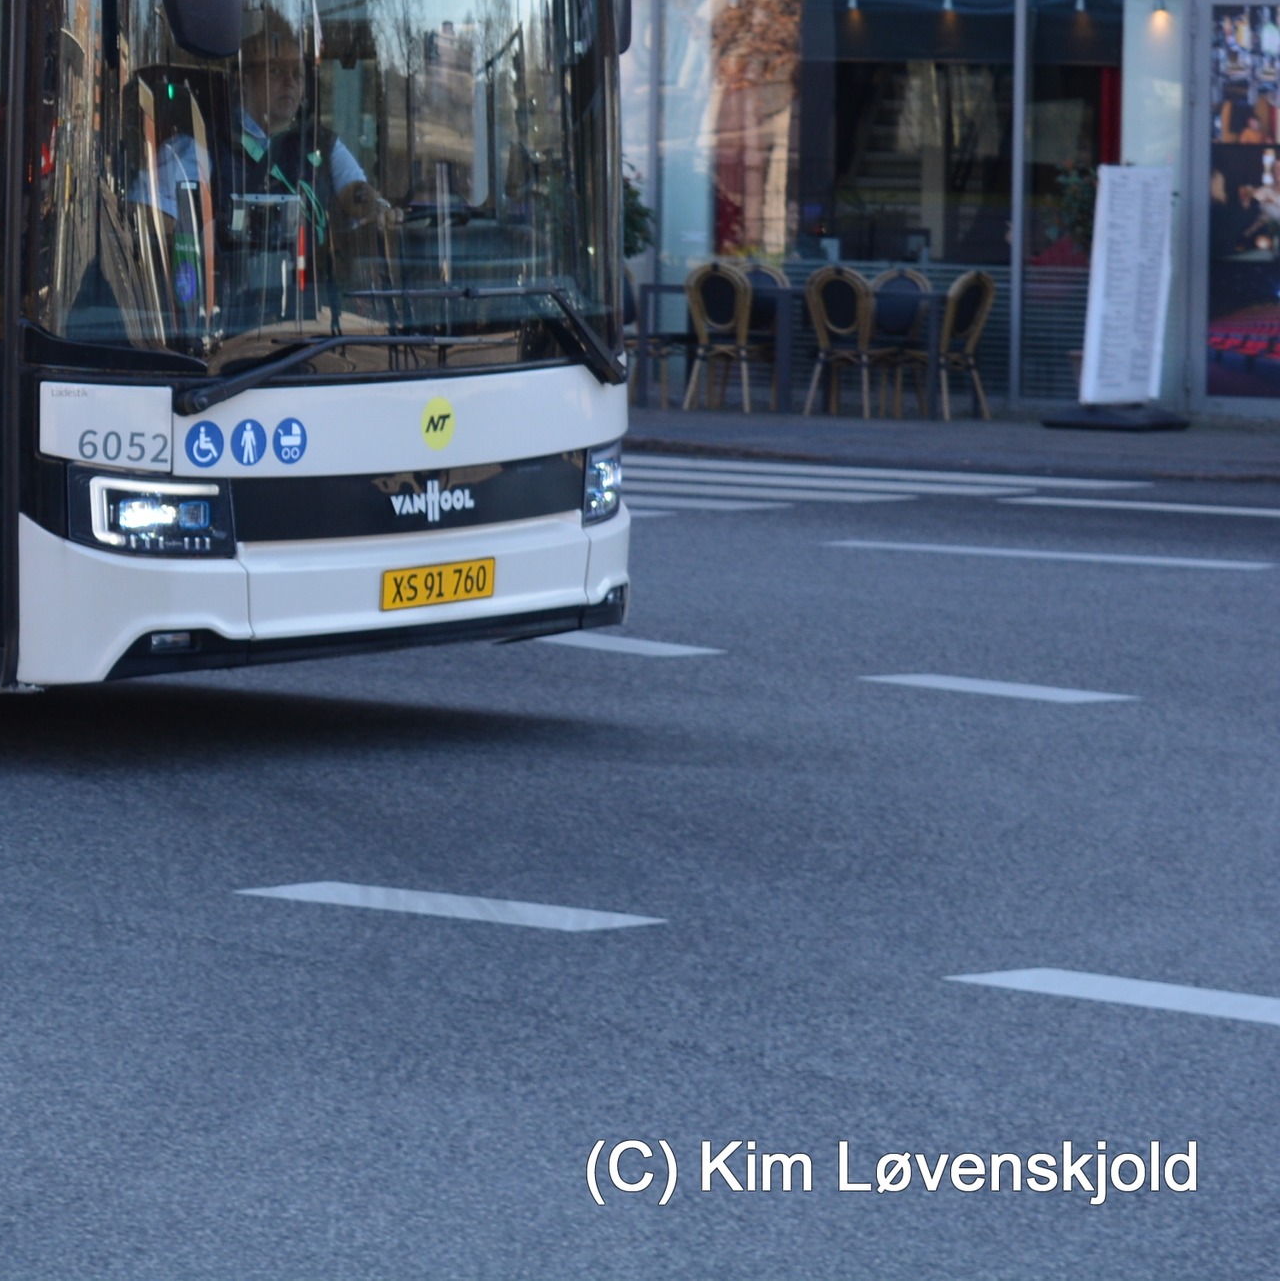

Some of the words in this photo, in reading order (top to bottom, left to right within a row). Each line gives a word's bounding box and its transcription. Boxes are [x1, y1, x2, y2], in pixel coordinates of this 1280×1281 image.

[425, 413, 451, 433] NT
[78, 428, 169, 463] 6052
[392, 574, 418, 603] XS
[424, 570, 444, 600] 91
[453, 565, 487, 595] 760
